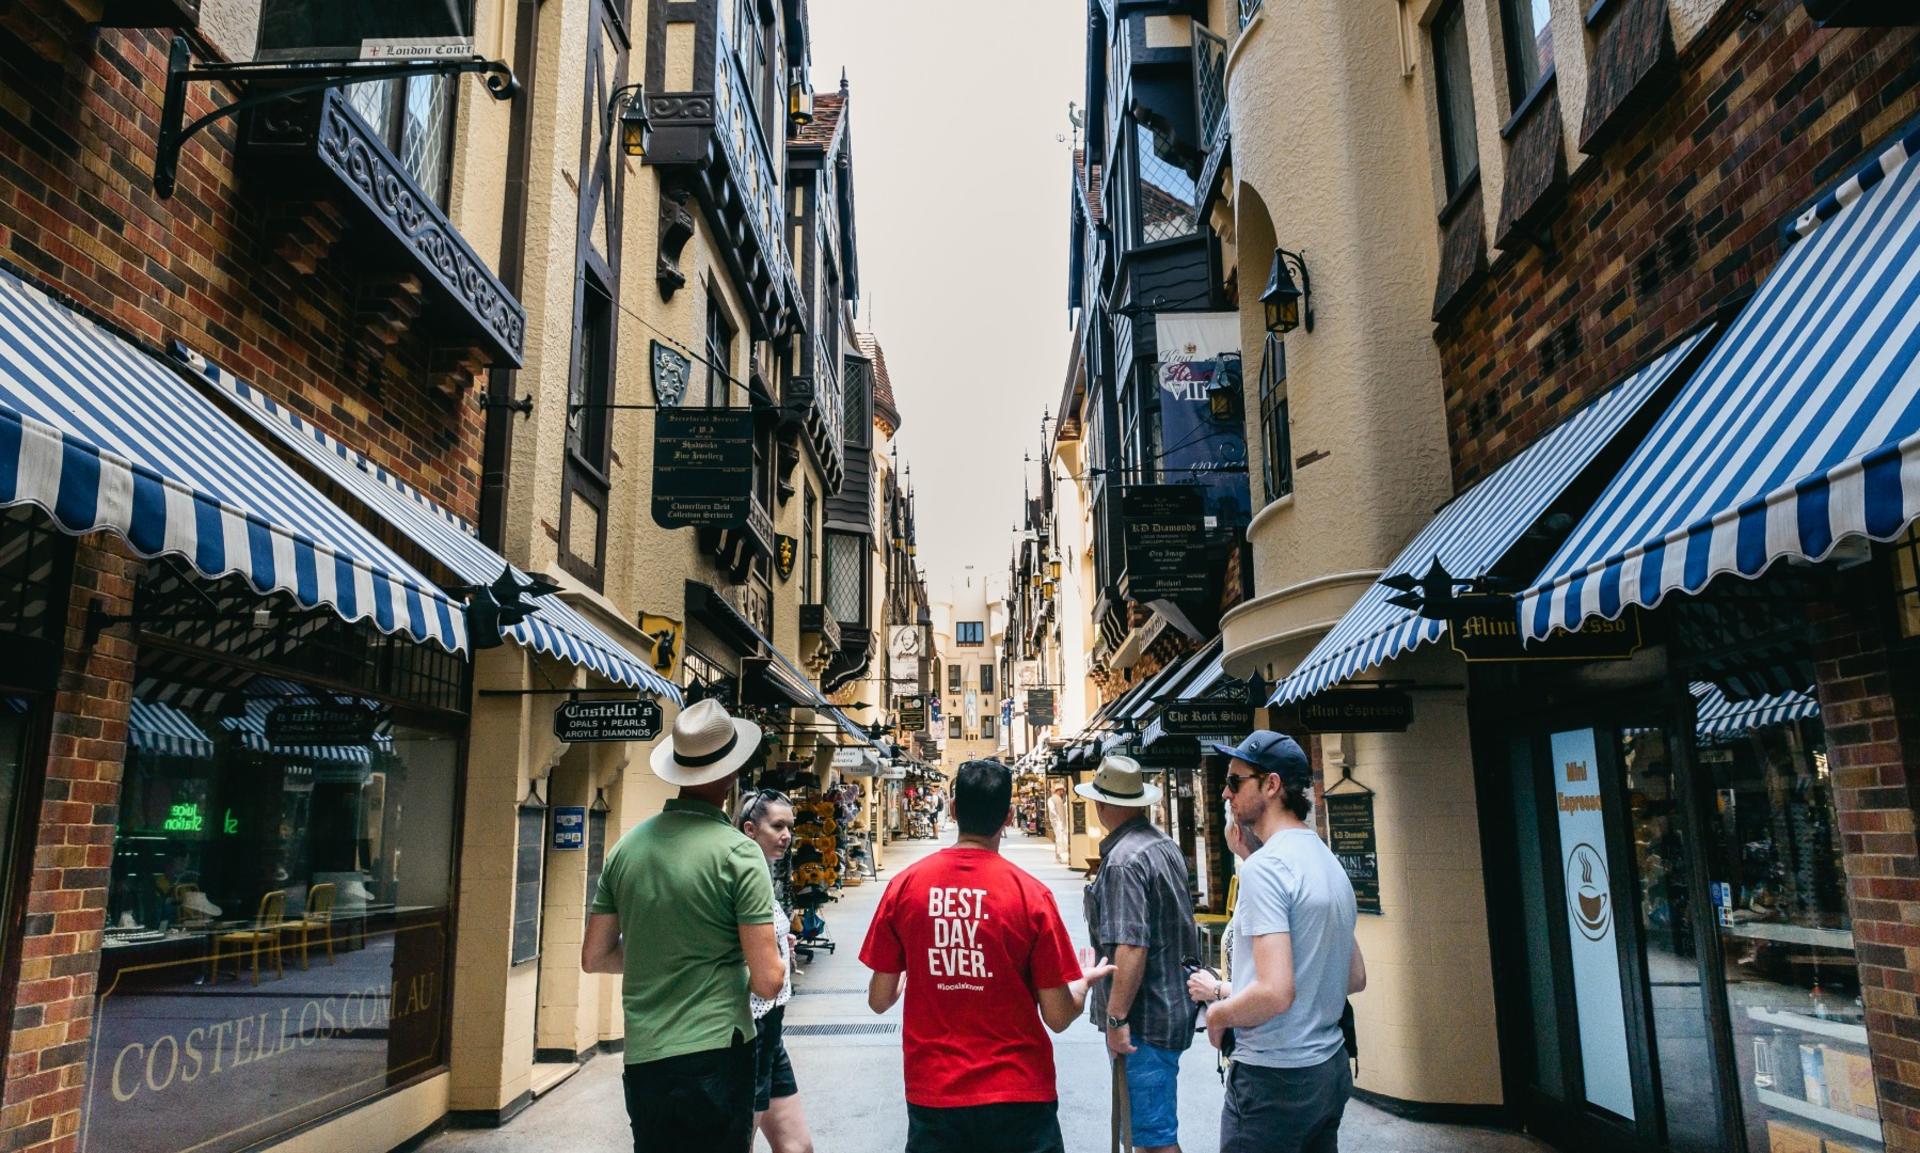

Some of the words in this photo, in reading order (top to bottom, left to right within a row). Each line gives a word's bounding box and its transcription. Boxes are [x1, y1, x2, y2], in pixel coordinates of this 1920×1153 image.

[386, 45, 432, 56] London
[435, 44, 473, 55] Court
[1159, 350, 1193, 362] King
[1152, 523, 1197, 532] Diamonds
[1462, 615, 1517, 638] Mini
[564, 704, 653, 718] Costello's
[1168, 710, 1188, 722] The
[1191, 710, 1218, 722] Rock
[1220, 710, 1249, 722] Shop
[569, 720, 599, 728] OPALS
[611, 719, 647, 727] PEARLS
[564, 730, 599, 738] ARGYLE
[602, 728, 651, 737] DIAMONDS
[1565, 761, 1587, 782] Mini
[928, 887, 989, 919] BEST.
[934, 918, 983, 949] DAY.
[928, 948, 993, 977] EVER.
